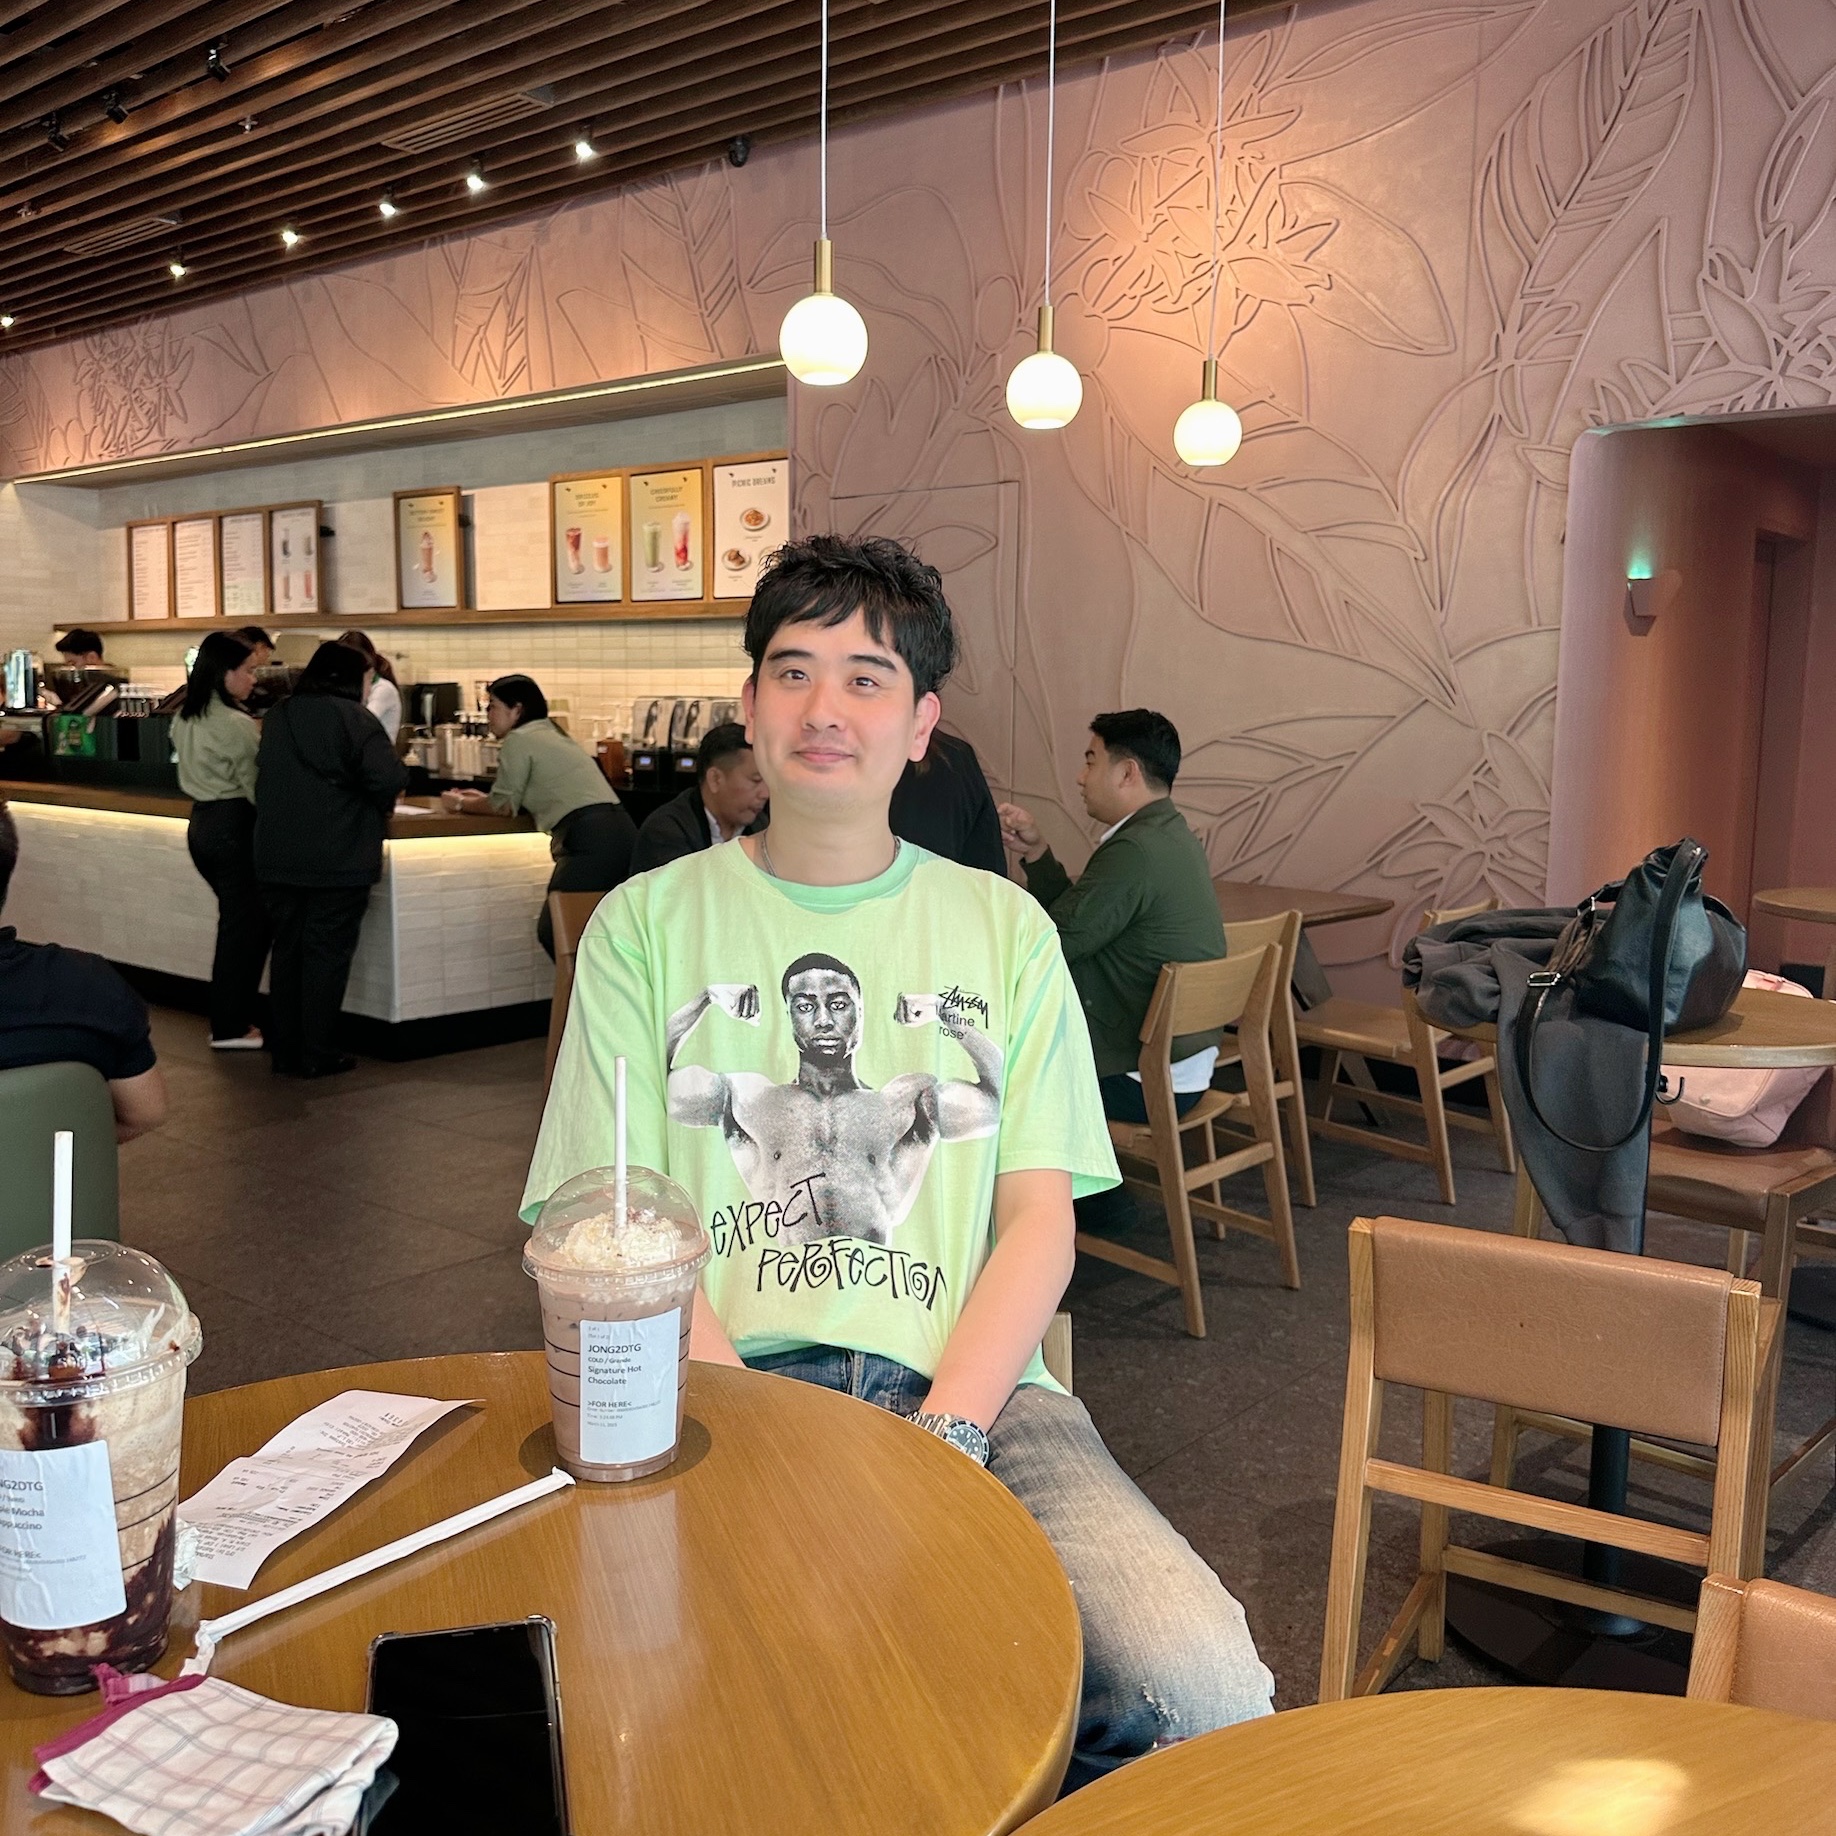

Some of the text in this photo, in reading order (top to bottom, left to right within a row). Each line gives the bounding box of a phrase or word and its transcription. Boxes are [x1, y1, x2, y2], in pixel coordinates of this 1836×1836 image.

[588, 1343, 642, 1354] JONG2DTG
[588, 1365, 642, 1375] Signature Hot
[588, 1376, 627, 1385] Chocolate
[12, 1507, 45, 1517] Mocha
